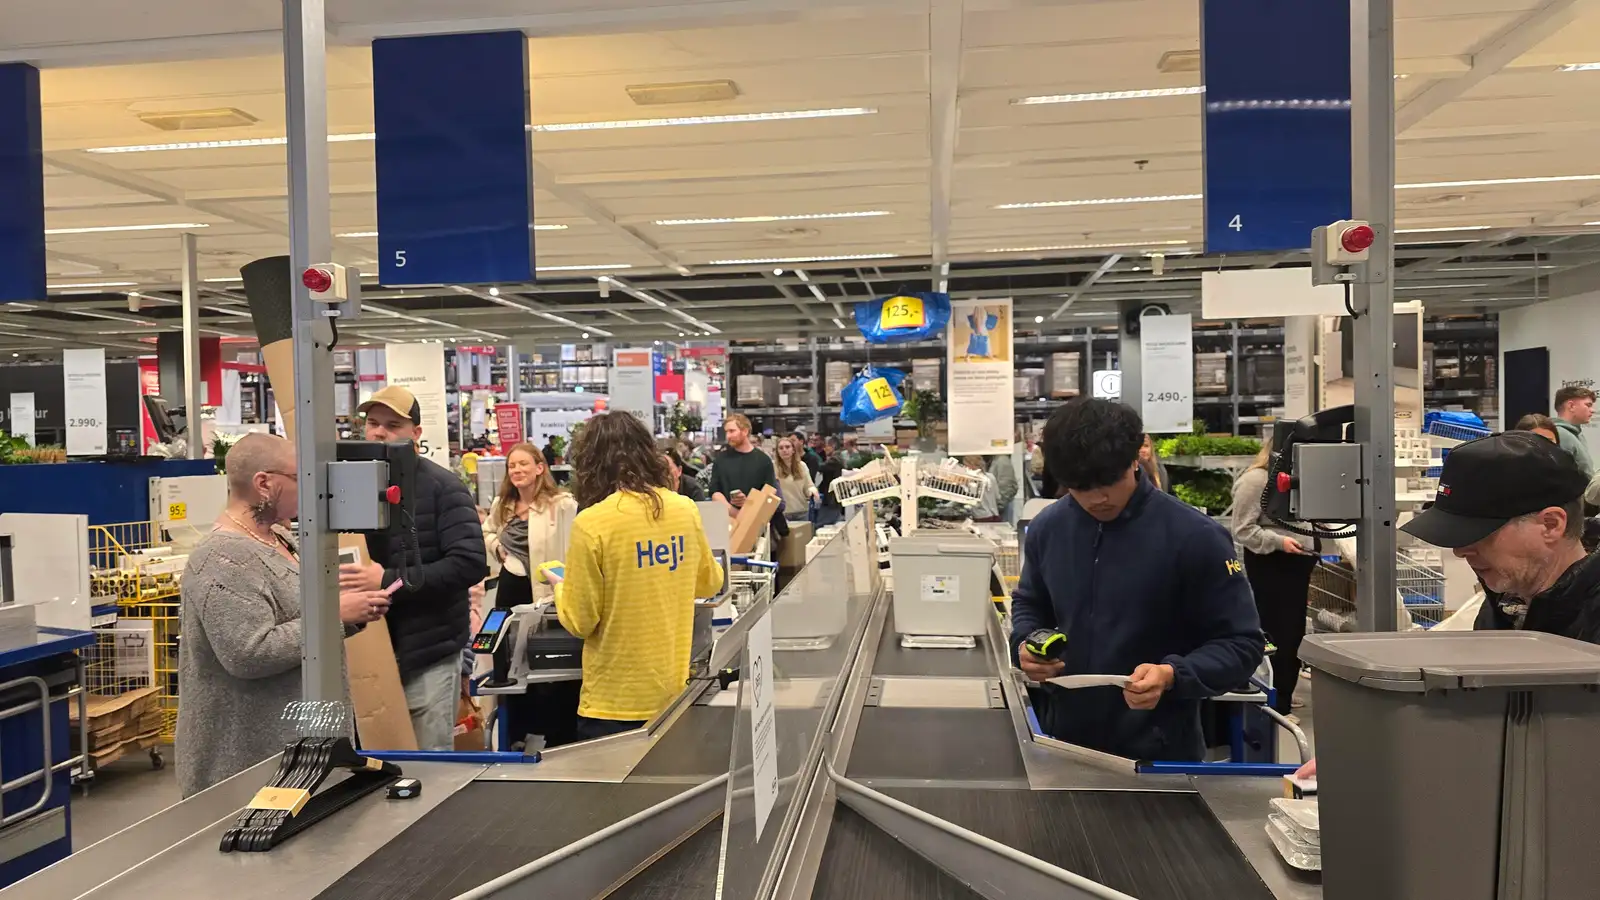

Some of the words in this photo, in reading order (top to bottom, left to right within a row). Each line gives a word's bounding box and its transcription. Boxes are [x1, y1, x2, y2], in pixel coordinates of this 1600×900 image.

[1228, 214, 1243, 232] 4
[395, 250, 407, 268] 5
[886, 304, 919, 319] 125,-
[1148, 392, 1188, 403] 2.490,-
[629, 409, 650, 419] 90,-
[69, 418, 103, 428] 2.990,-
[420, 440, 442, 457] 5,-
[170, 505, 187, 516] 95,-
[636, 535, 684, 571] Hej!
[1225, 558, 1242, 575] He
